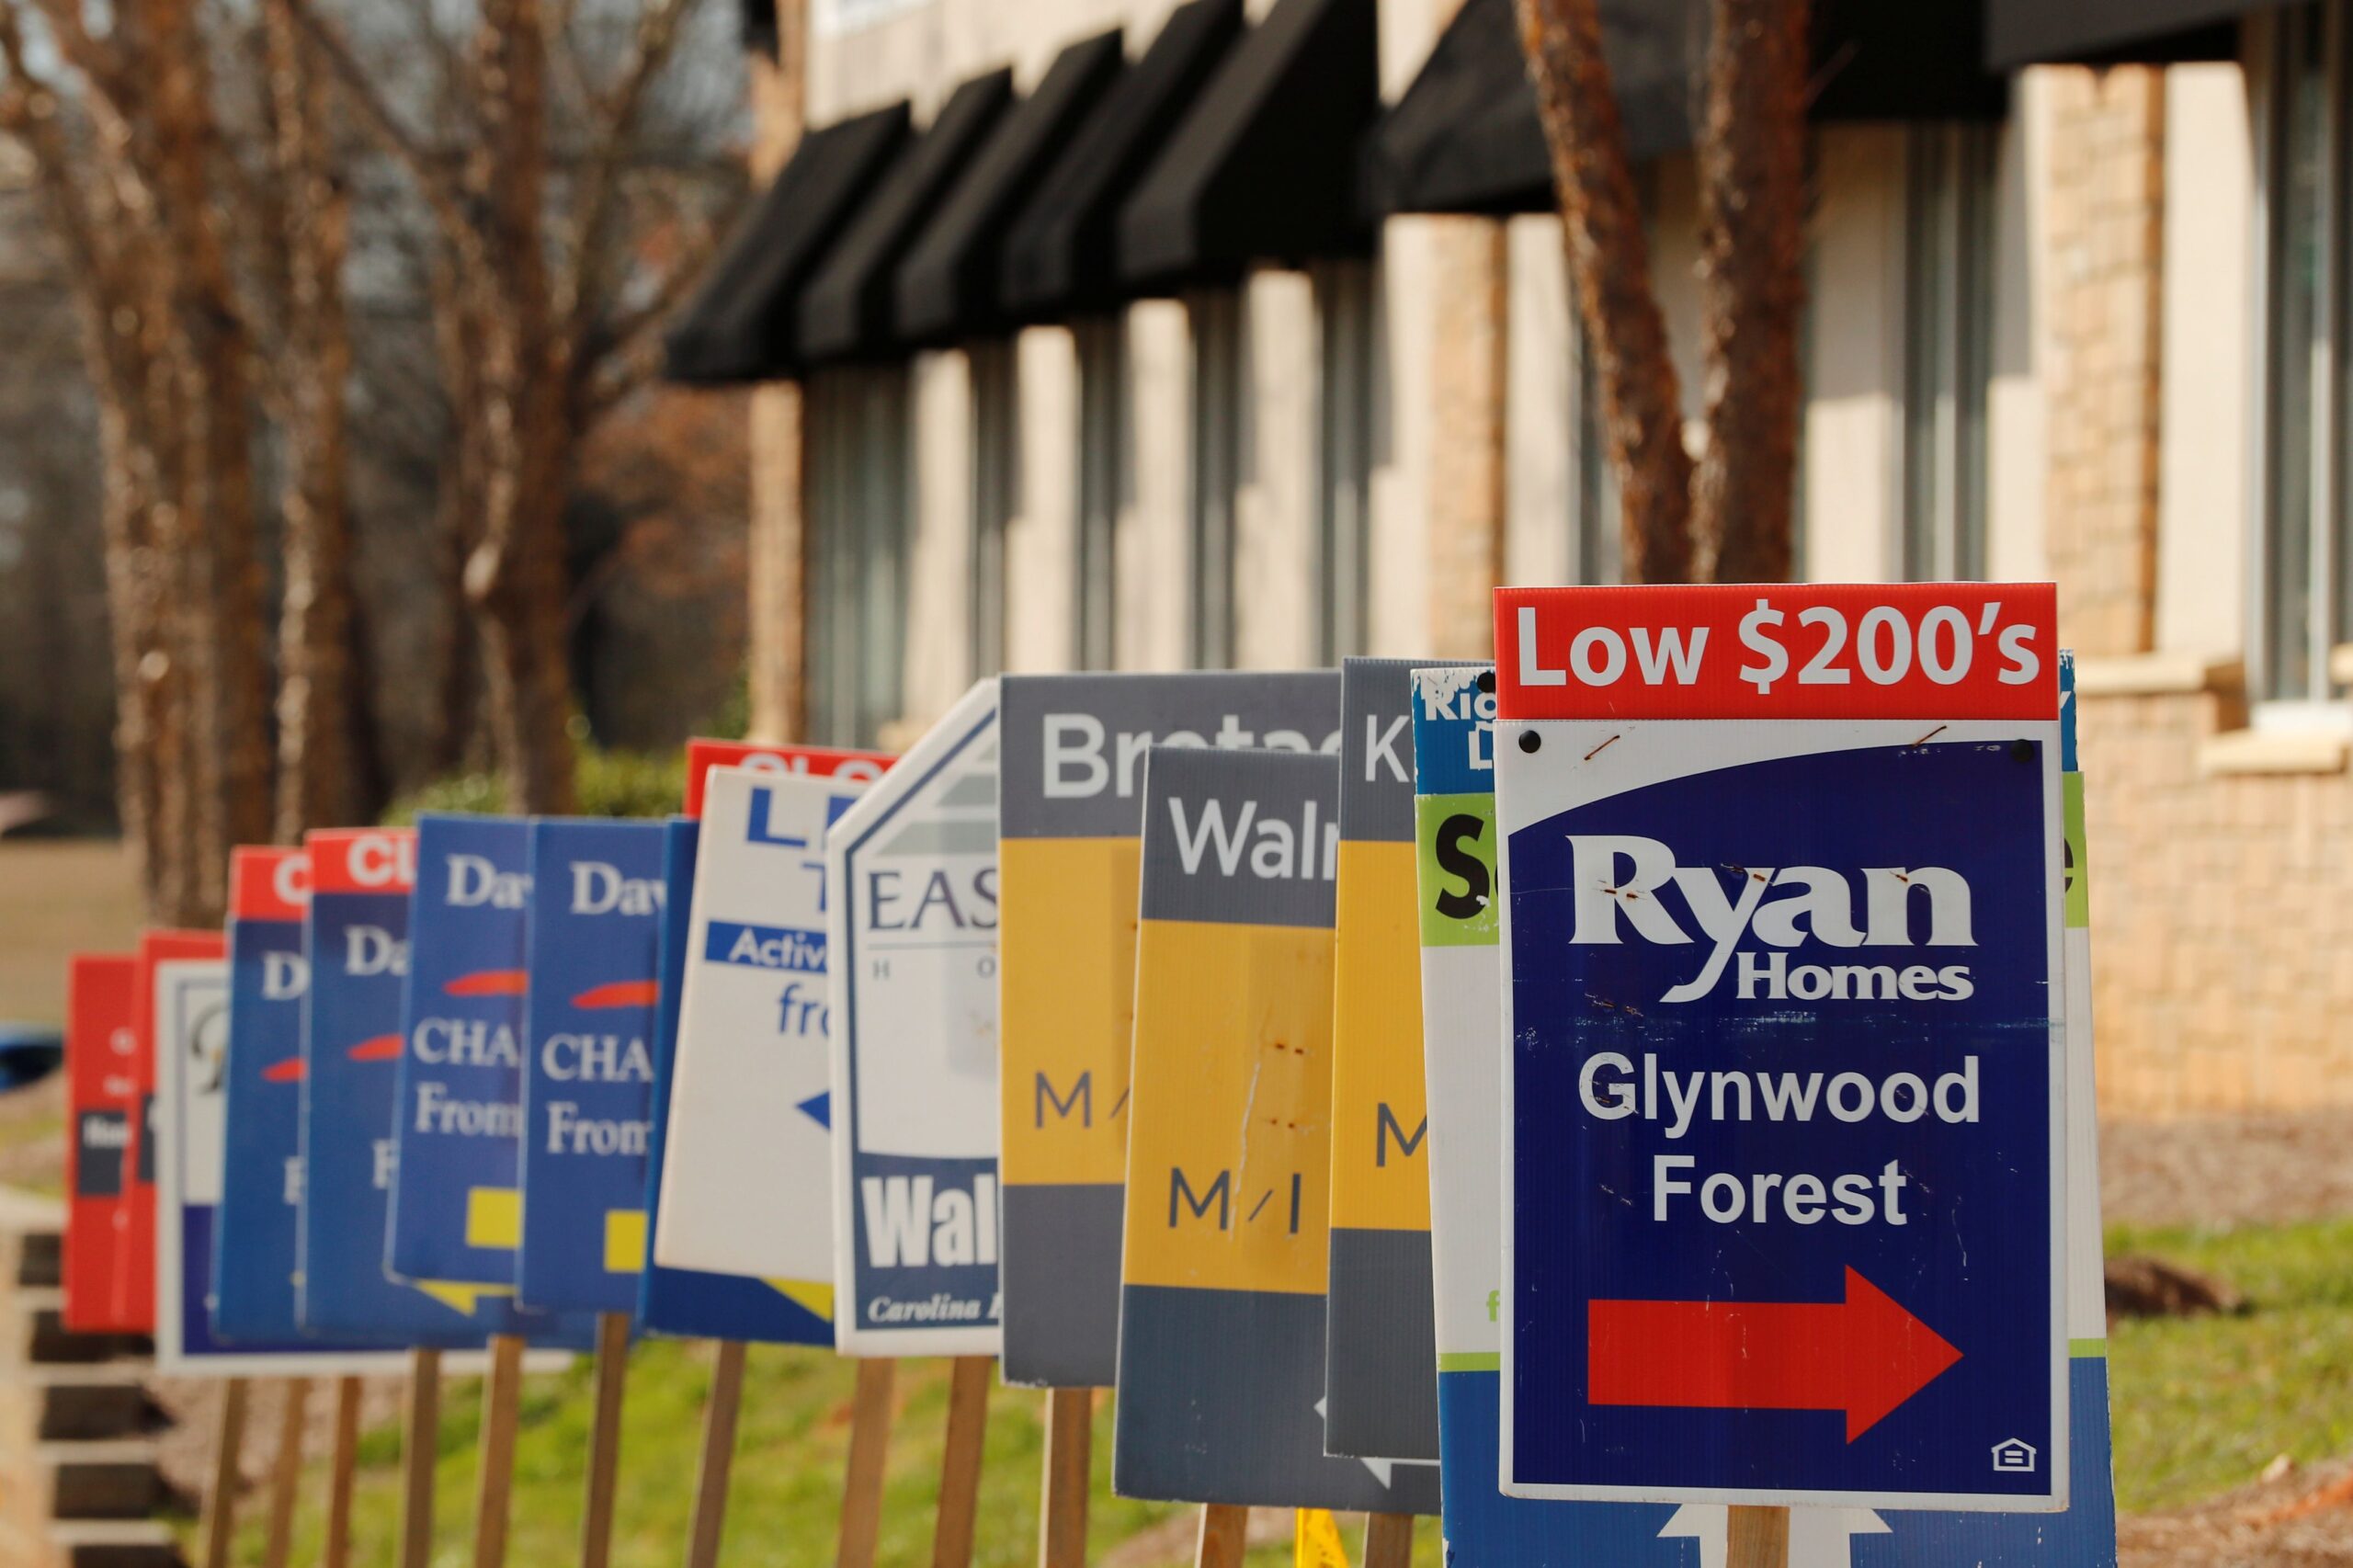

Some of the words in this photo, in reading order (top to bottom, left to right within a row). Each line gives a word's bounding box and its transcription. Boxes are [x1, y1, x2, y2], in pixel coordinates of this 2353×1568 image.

[1518, 607, 1710, 687] Low
[1738, 598, 2040, 695] $200's
[1365, 714, 1411, 782] K
[1436, 813, 1499, 919] S
[1565, 835, 1979, 1003] Ryan
[778, 982, 828, 1037] fr
[1736, 951, 1974, 1001] Homes
[1578, 1051, 1979, 1139] Glynwood
[861, 1174, 996, 1267] Wal
[1654, 1154, 1907, 1226] Forest
[868, 1292, 982, 1323] Carolina
